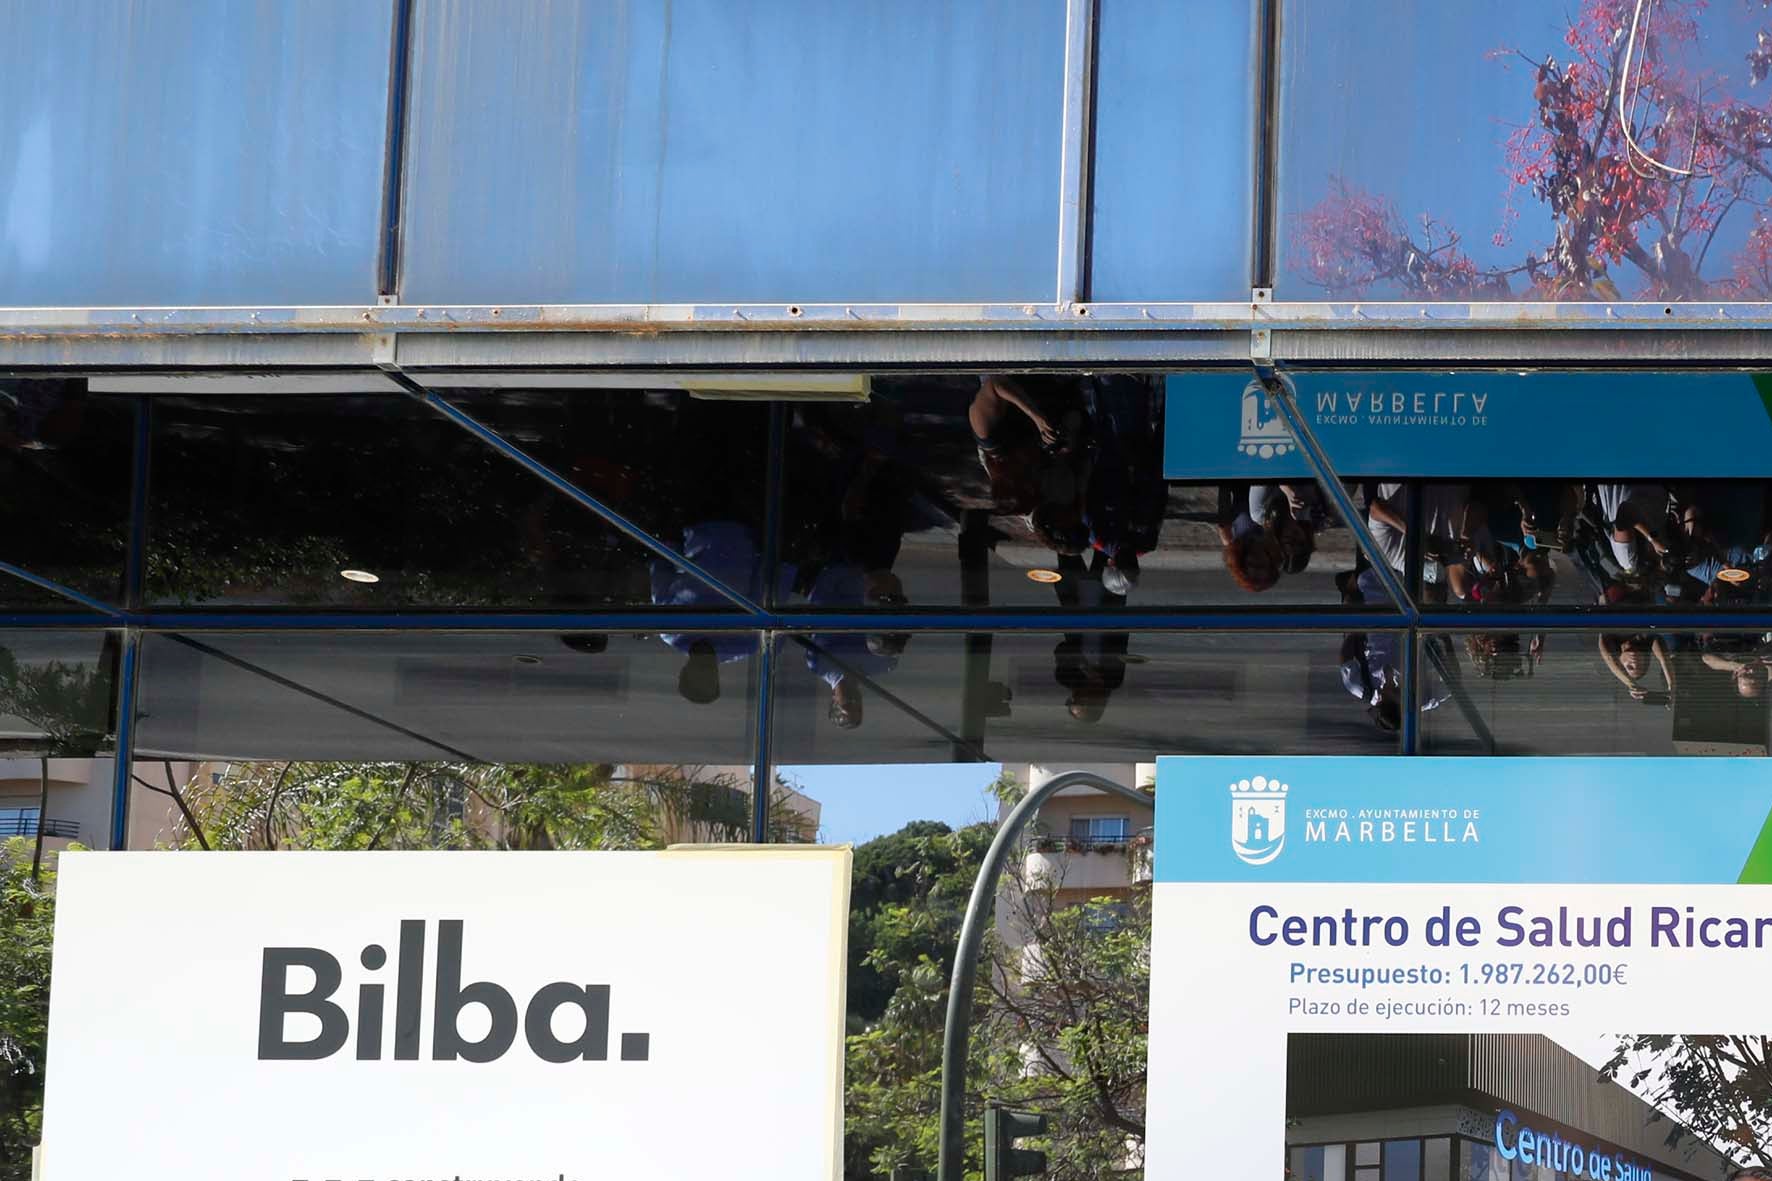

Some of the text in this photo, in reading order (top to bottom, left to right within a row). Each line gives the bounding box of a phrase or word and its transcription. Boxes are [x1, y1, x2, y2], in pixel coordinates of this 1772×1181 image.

[1358, 809, 1458, 819] AYUNTAMIENTO
[1463, 809, 1480, 819] DE
[1305, 820, 1480, 843] MARBELLA
[1249, 905, 1409, 947] Centro
[1425, 906, 1482, 947] de
[1495, 906, 1632, 948] Salud
[1290, 962, 1628, 989] Presupuesto: 1.987.262,00€
[257, 919, 650, 1064] Bilba.
[1289, 997, 1570, 1020] Plazo de ejecución: 12 meses
[1495, 1108, 1584, 1176] Centro
[1588, 1146, 1611, 1181] de
